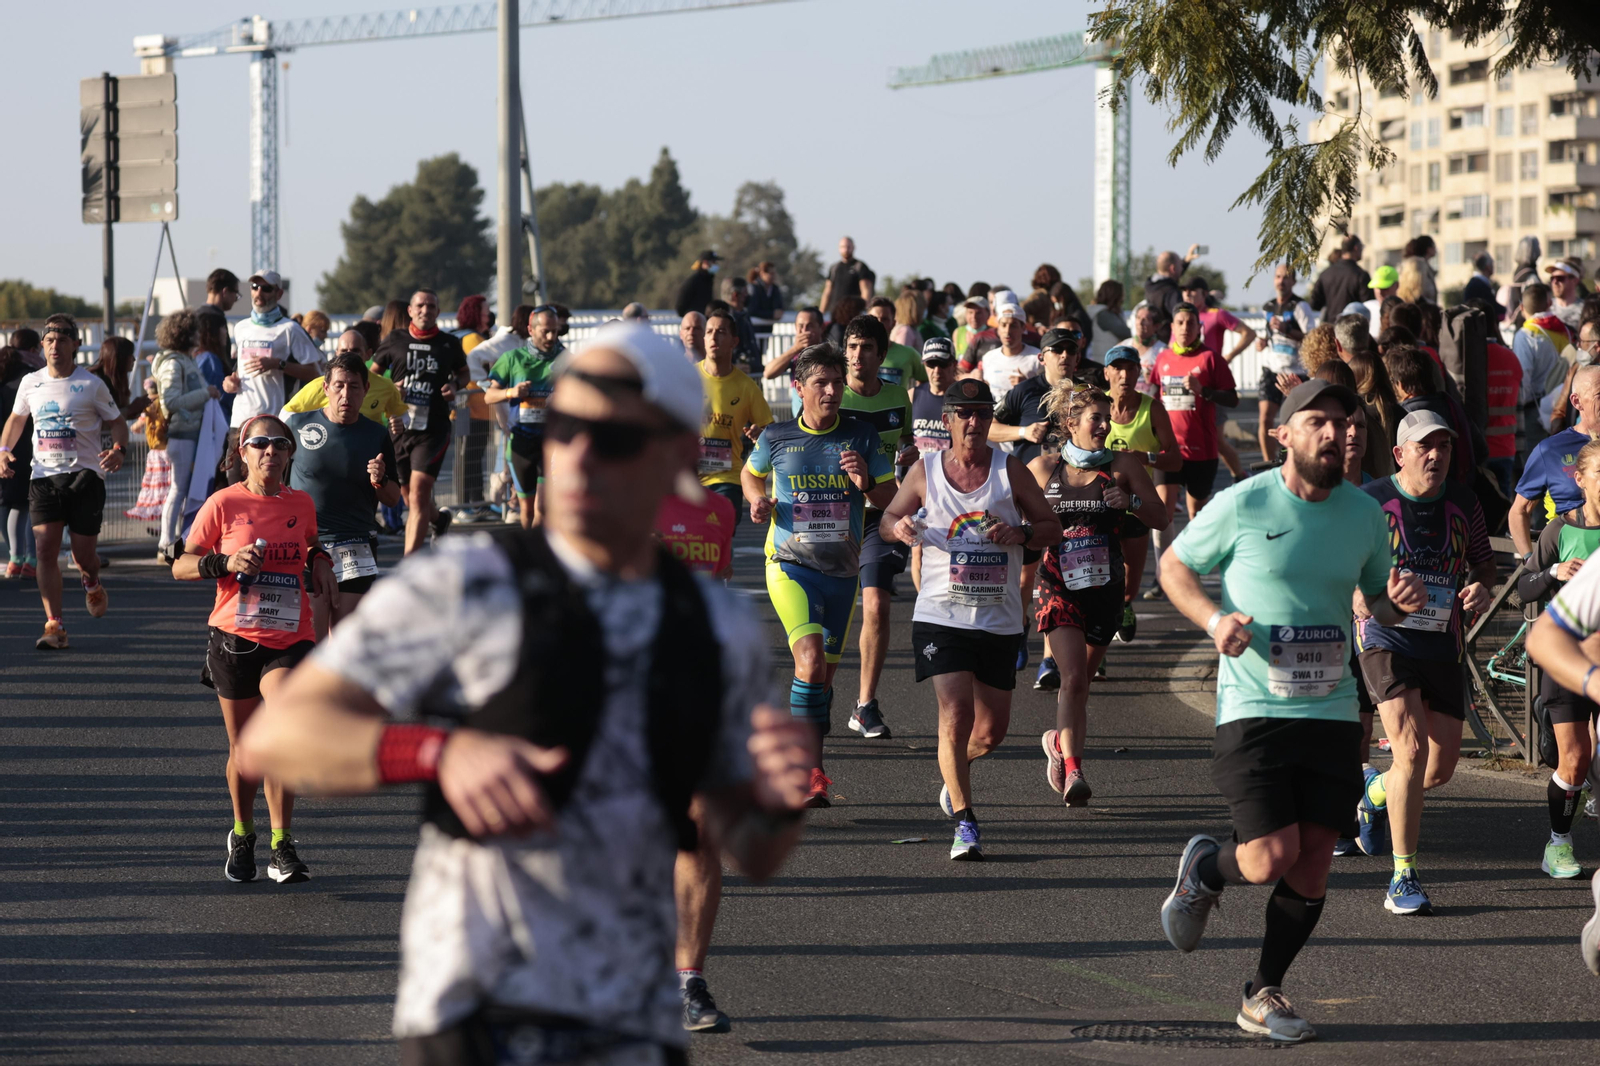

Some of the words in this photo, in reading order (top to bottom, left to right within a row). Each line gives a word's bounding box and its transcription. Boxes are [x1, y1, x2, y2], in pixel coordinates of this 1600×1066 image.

[787, 474, 850, 490] TUSSAM
[811, 493, 843, 501] ZURICH
[811, 510, 832, 518] 6292
[807, 521, 836, 529] ÁRBITRO
[1073, 538, 1103, 548] ZURICH
[339, 549, 358, 559] 7979
[970, 555, 1002, 563] ZURICH
[1076, 554, 1096, 564] 6483
[1082, 567, 1094, 575] PAZ
[261, 574, 297, 585] ZURICH
[969, 572, 990, 581] 6312
[952, 584, 969, 592] QUIM
[970, 585, 1004, 593] CARINHAS
[259, 592, 282, 603] 9407
[258, 607, 280, 616] MARY
[1297, 629, 1339, 639] ZURICH
[1296, 652, 1322, 663] 9410
[1292, 670, 1312, 679] SWA
[1313, 670, 1324, 679] 13
